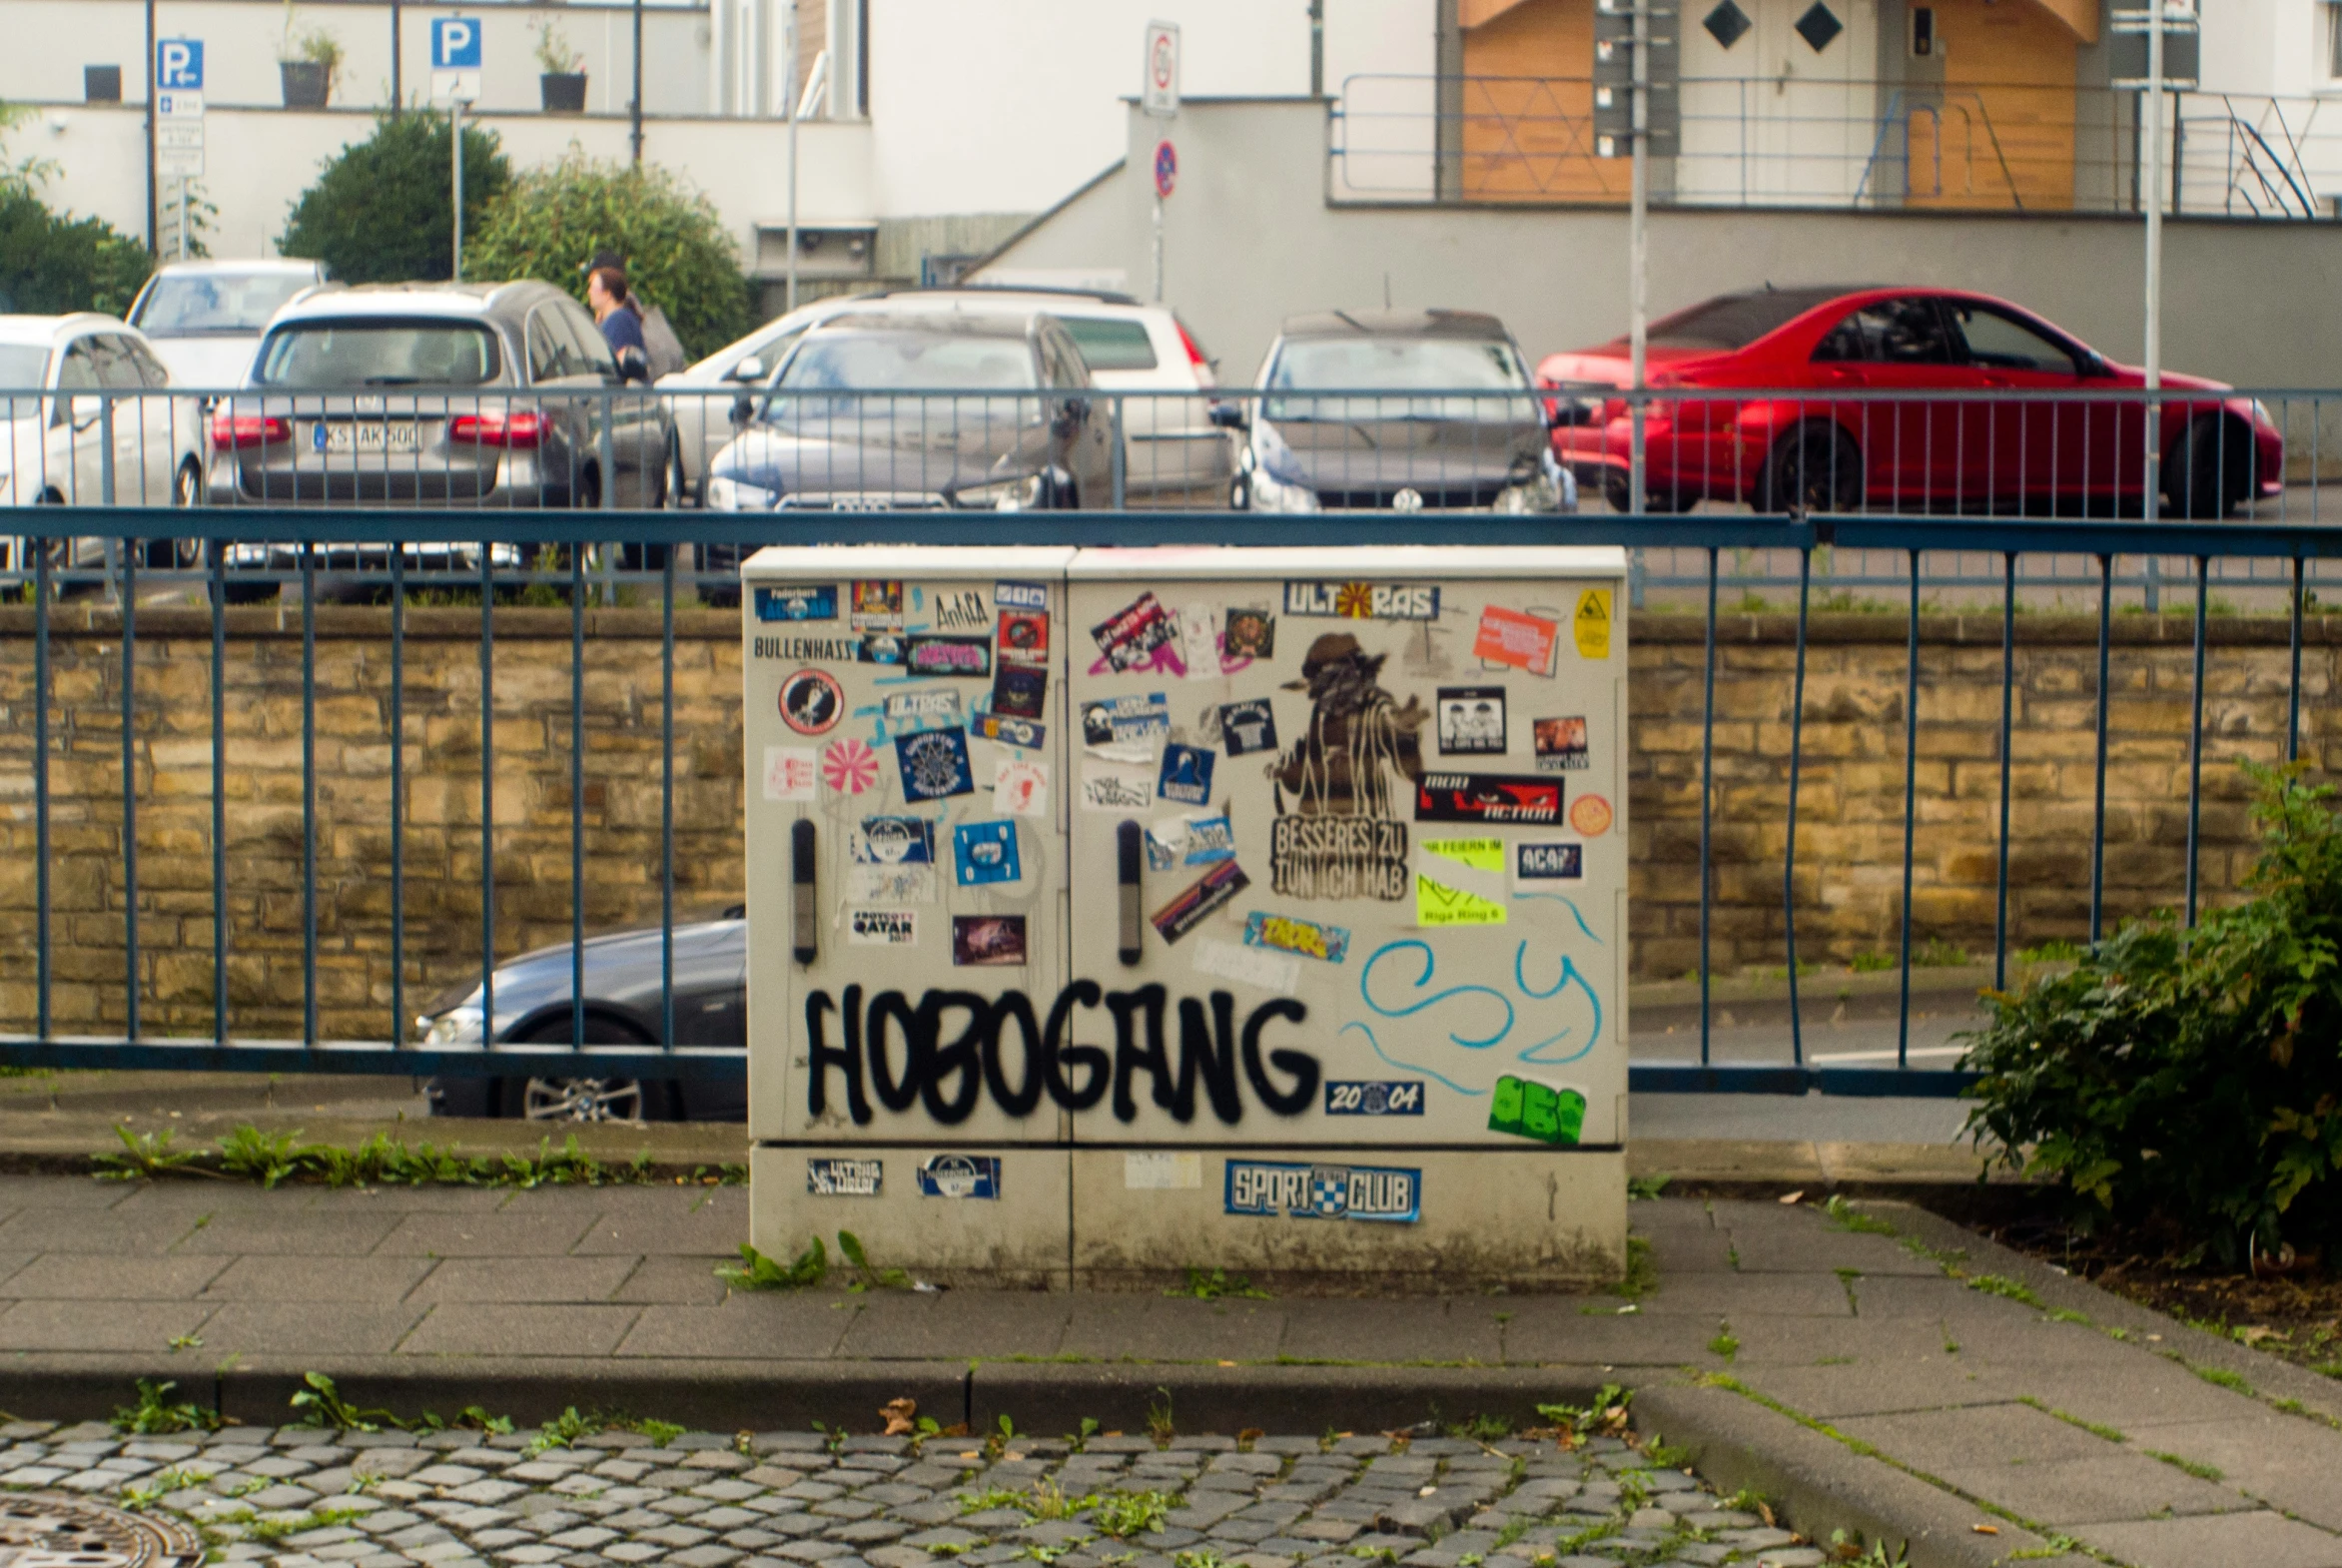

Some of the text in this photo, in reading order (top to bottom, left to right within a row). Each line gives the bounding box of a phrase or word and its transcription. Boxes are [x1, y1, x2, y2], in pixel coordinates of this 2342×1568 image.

[441, 21, 471, 64] P
[163, 43, 191, 86] P
[361, 425, 383, 443] AK
[754, 636, 852, 661] BULLENHASS
[1276, 819, 1403, 857] BESSERES ZU
[1443, 839, 1486, 853] FEIERN
[1274, 859, 1314, 897] TUN
[1320, 860, 1356, 898] ICH
[1362, 861, 1403, 898] HAB
[853, 920, 913, 937] QATAR
[805, 979, 1321, 1128] HOBOGANG
[1330, 1084, 1419, 1111] 20 04
[1233, 1168, 1410, 1213] SPORT CLUB
